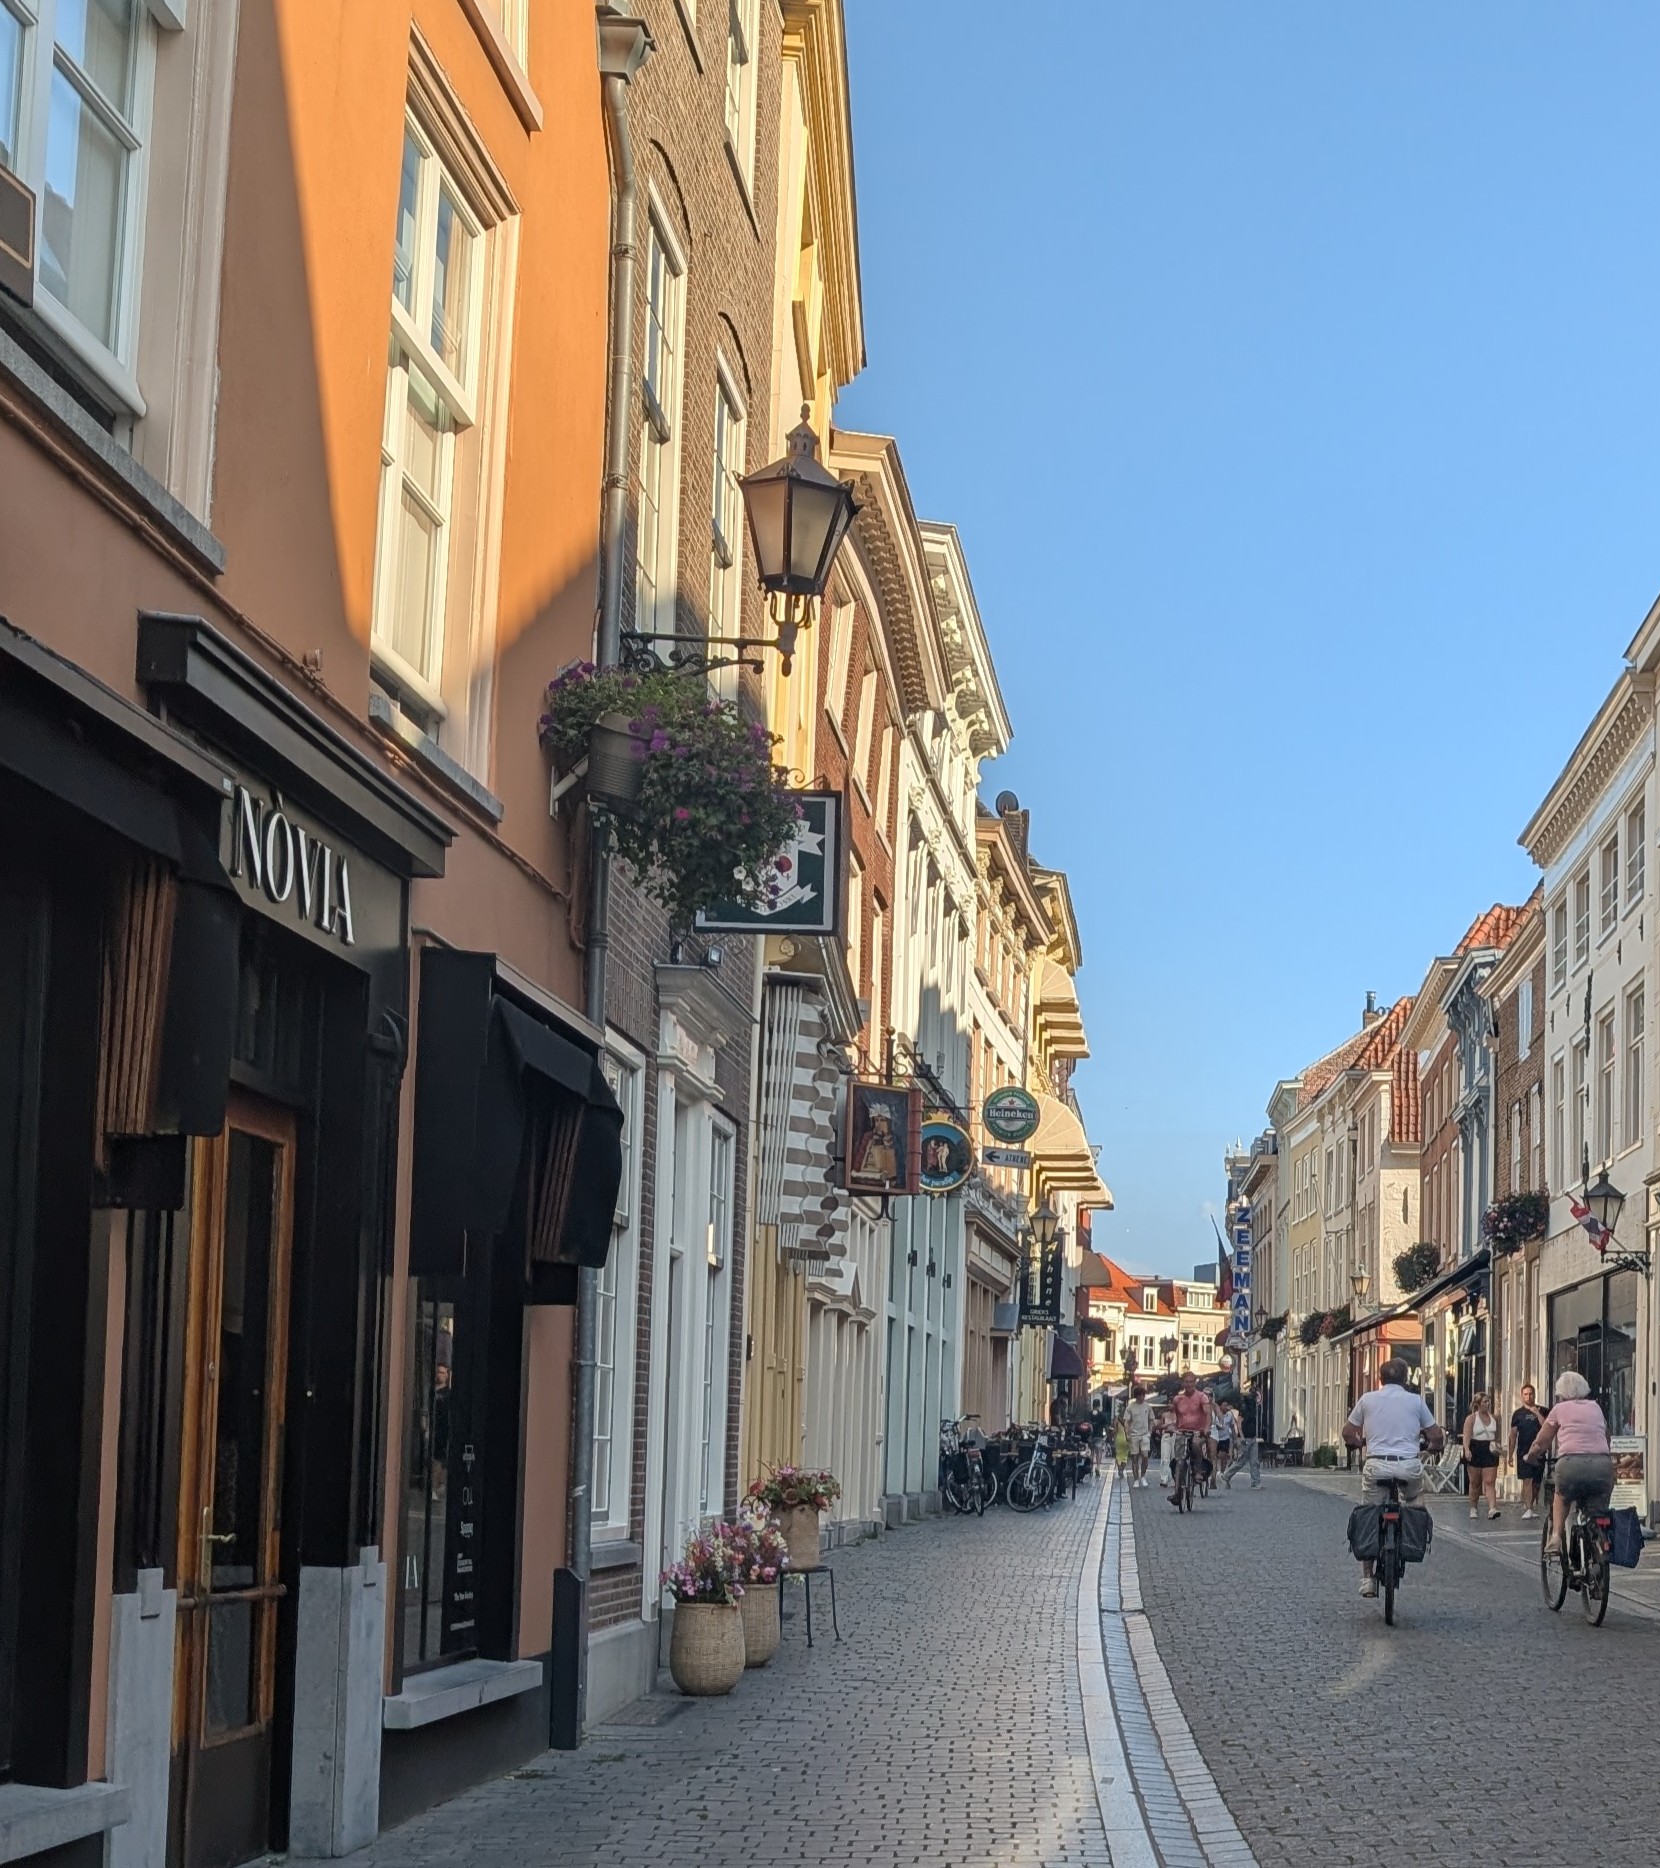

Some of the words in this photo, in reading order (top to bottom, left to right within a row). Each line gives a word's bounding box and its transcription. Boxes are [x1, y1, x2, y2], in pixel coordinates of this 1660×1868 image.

[989, 1108, 1034, 1120] Heineken
[1004, 1152, 1028, 1165] ATHENE
[1044, 1240, 1059, 1307] Athene
[1234, 1208, 1250, 1331] ZEEMAN
